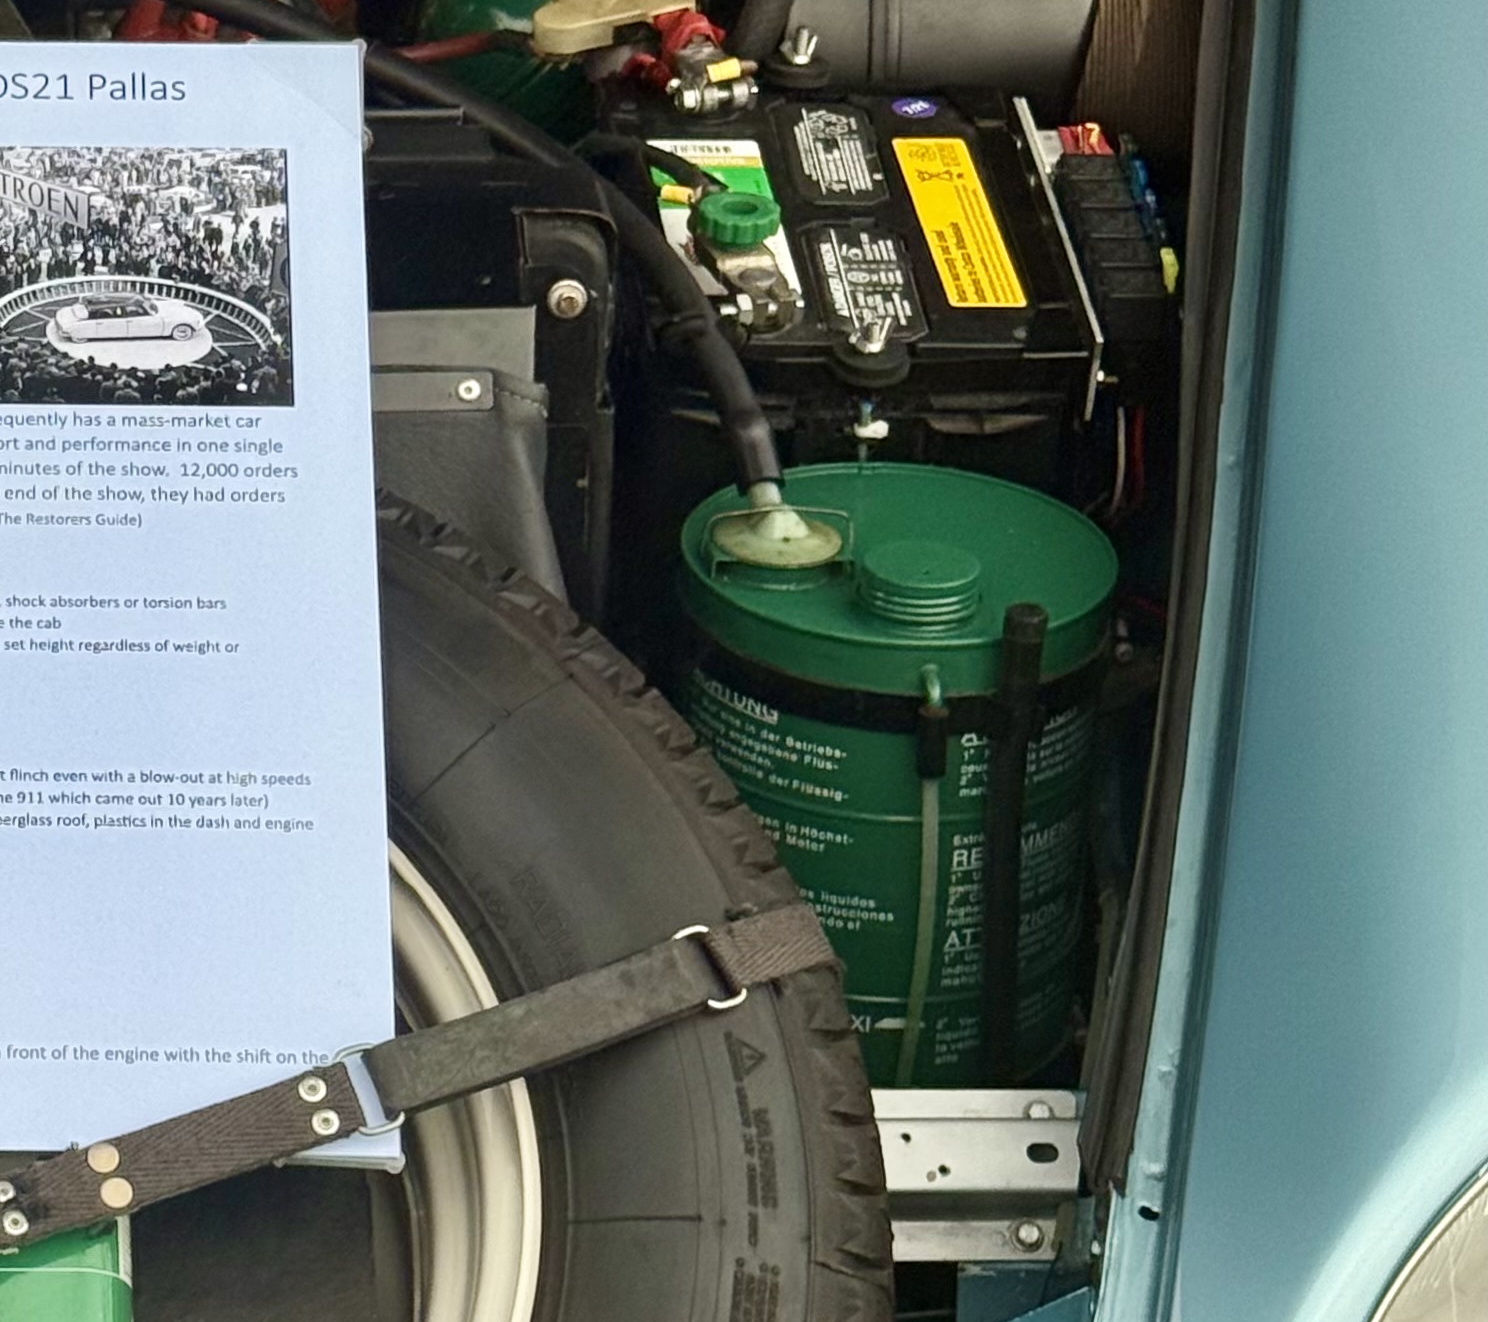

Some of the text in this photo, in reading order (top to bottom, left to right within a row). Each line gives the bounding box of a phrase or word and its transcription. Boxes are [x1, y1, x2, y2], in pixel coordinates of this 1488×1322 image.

[88, 71, 186, 101] Pallas
[16, 791, 44, 805] 911
[48, 791, 91, 805] which
[95, 794, 134, 805] came
[138, 793, 164, 806] out
[168, 793, 186, 806] 10
[188, 796, 227, 809] years
[6, 1044, 47, 1060] front
[51, 1045, 68, 1060] of
[73, 1045, 100, 1061] the
[104, 1047, 160, 1065] engine
[164, 1047, 200, 1063] with
[205, 1047, 232, 1063] the
[236, 1048, 272, 1064] shift
[276, 1053, 297, 1065] on
[302, 1049, 329, 1065] the
